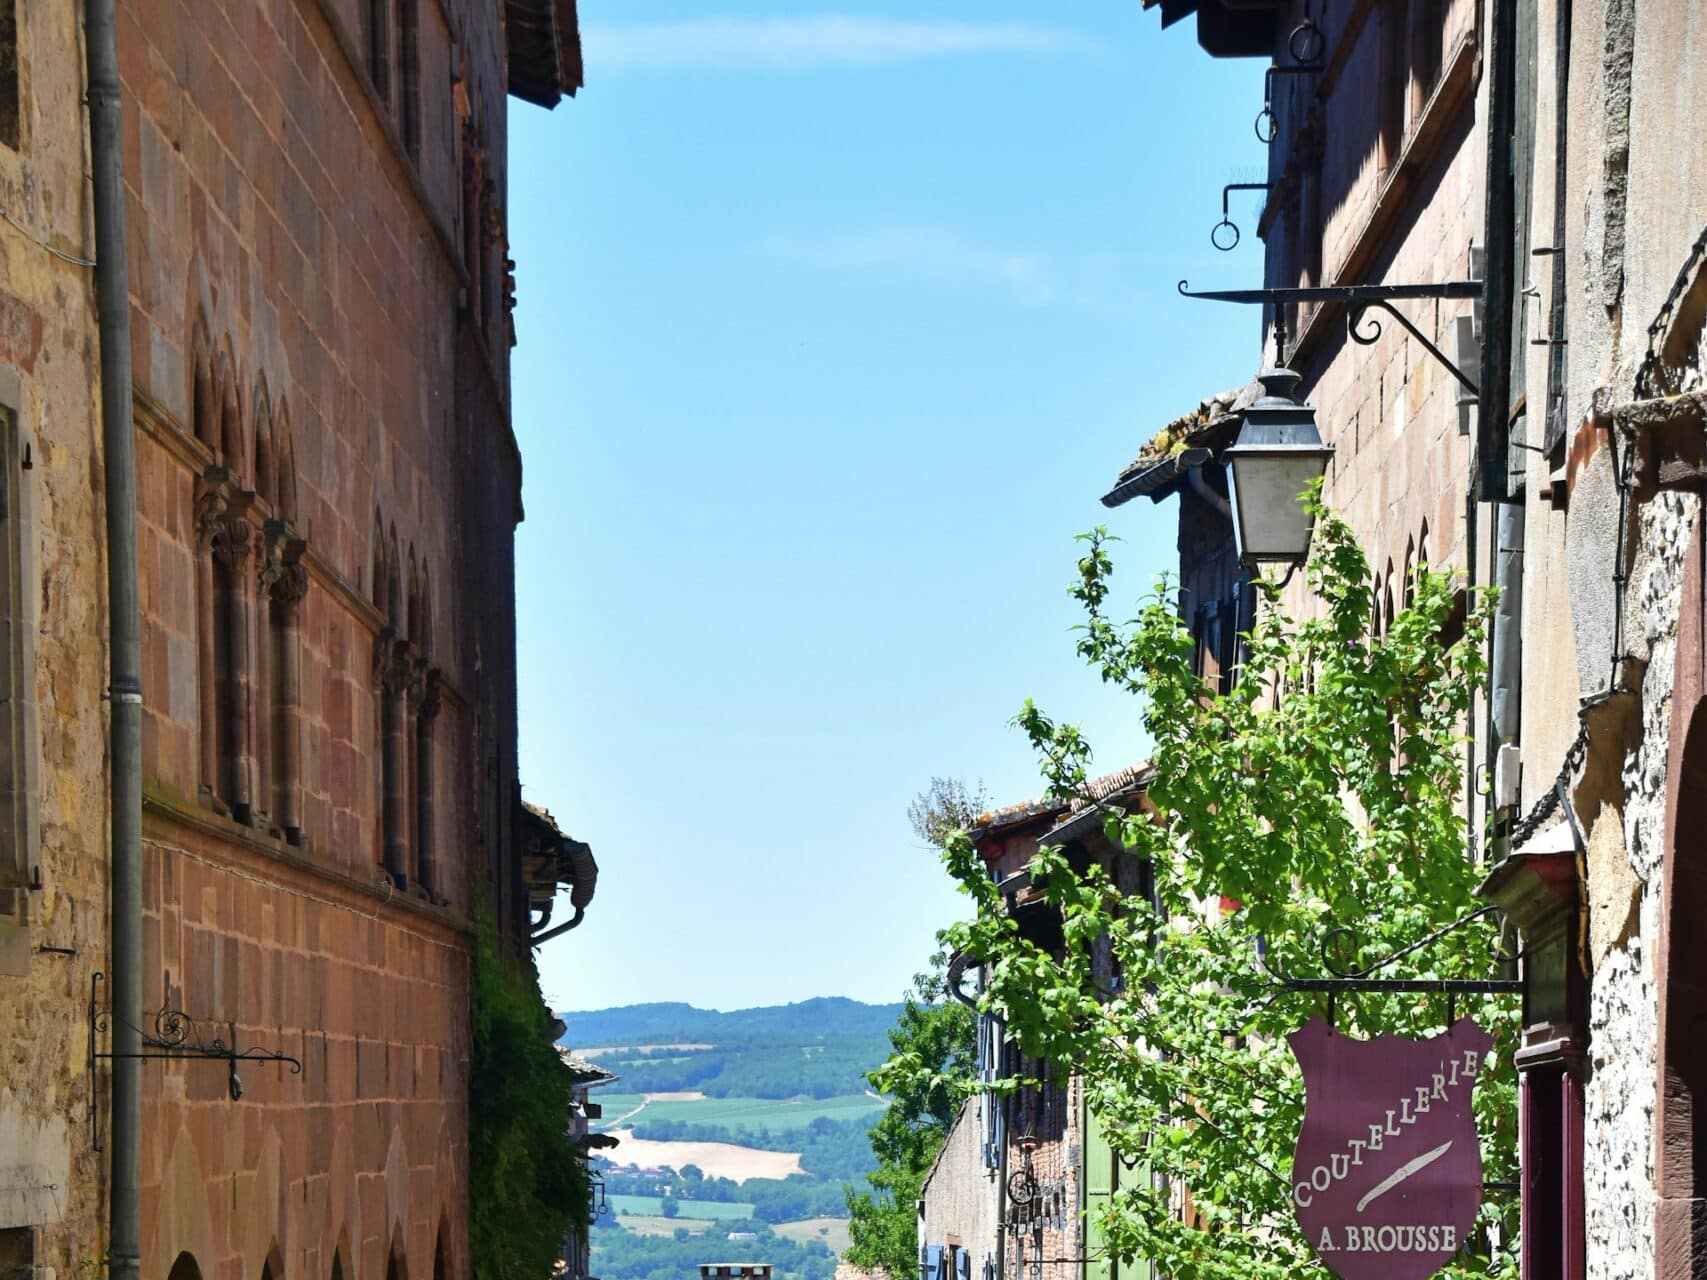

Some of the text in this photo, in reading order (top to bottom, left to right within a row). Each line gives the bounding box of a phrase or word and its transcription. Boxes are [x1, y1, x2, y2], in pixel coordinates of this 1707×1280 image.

[1293, 1050, 1478, 1208] COUTELLERIE
[1317, 1226, 1457, 1252] A. BROUSSE
